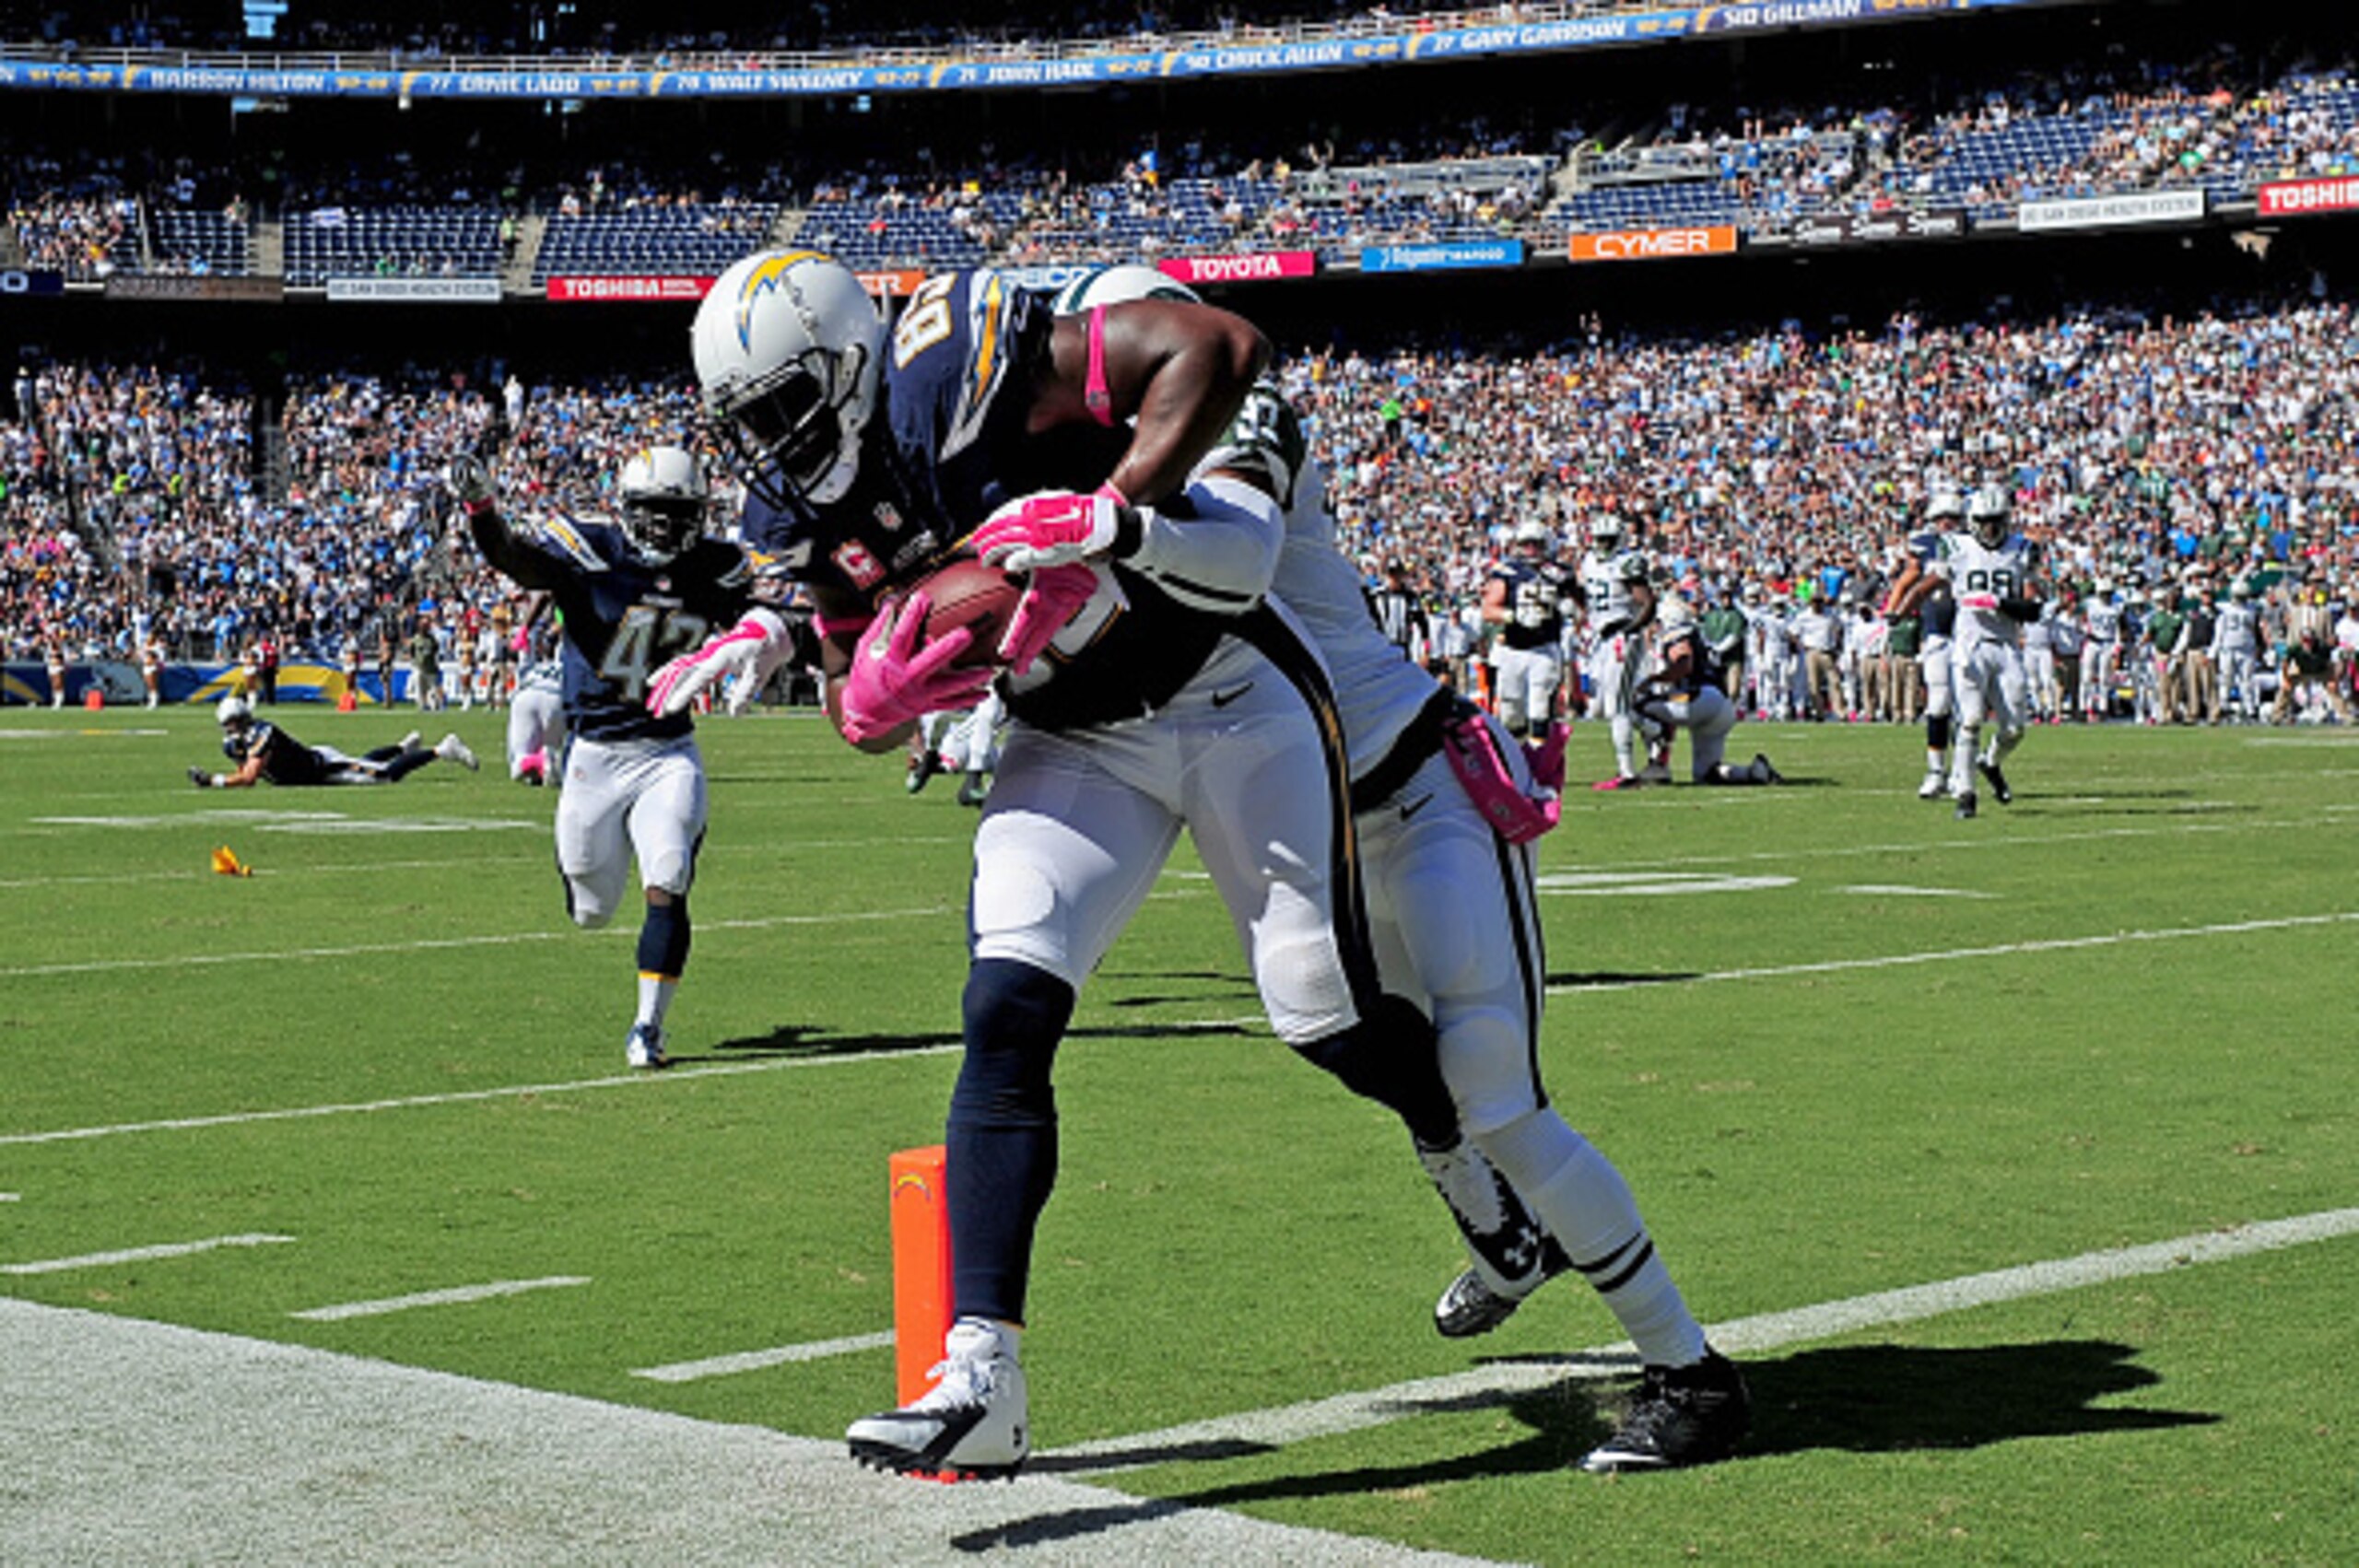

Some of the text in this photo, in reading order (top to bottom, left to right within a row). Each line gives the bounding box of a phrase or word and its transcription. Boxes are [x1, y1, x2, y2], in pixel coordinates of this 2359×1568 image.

[1461, 29, 1519, 51] GARY
[1594, 230, 1710, 256] CYMER
[1190, 254, 1282, 280] TOYOTA
[565, 278, 661, 297] TOSHIBA
